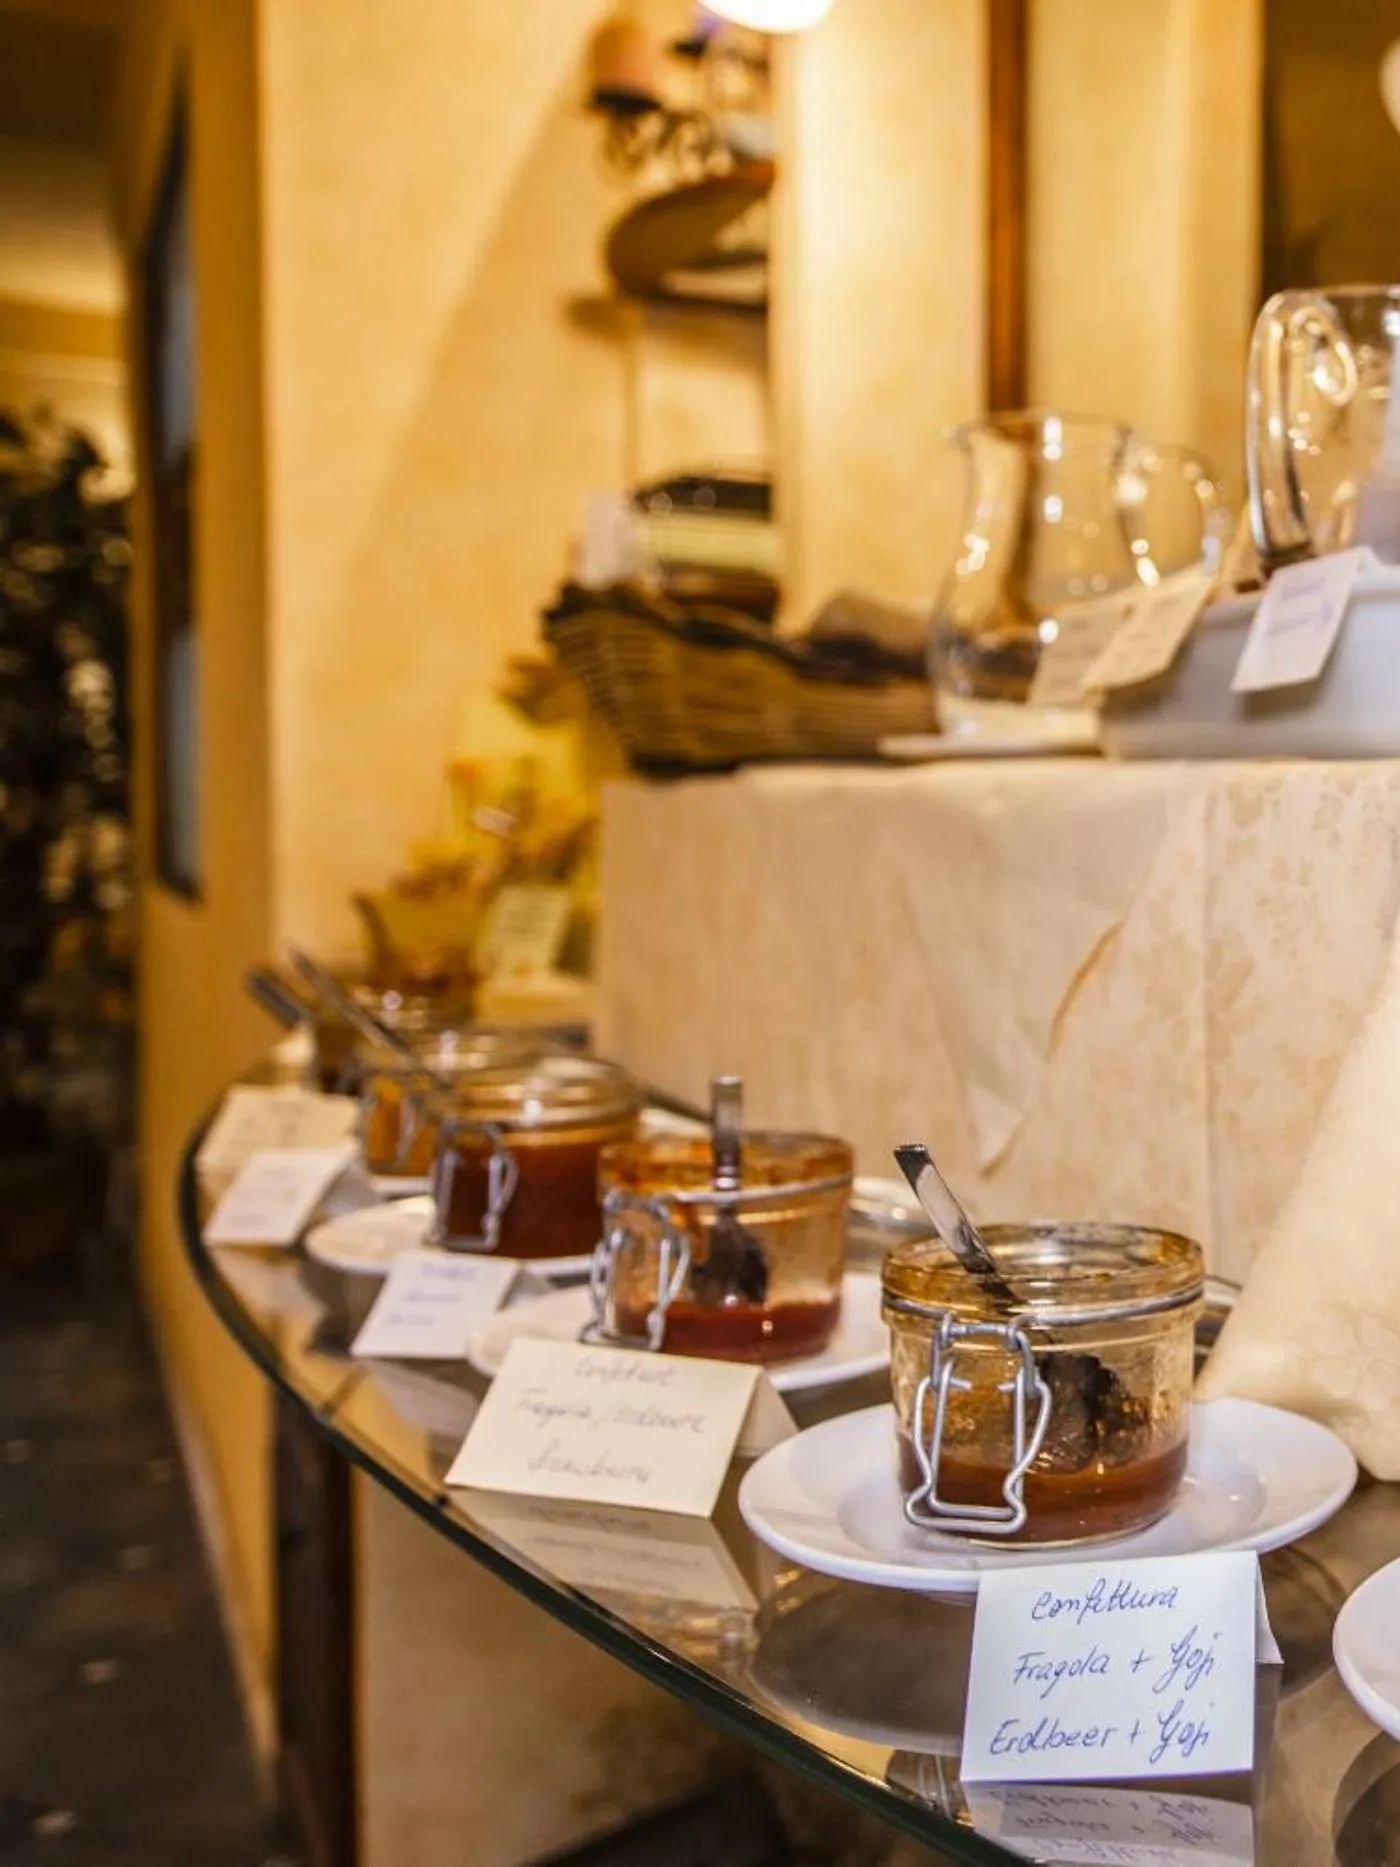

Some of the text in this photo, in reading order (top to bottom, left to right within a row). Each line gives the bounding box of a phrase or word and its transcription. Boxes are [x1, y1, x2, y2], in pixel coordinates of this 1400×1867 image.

[1032, 1578, 1180, 1625] Confettura
[1013, 1645, 1111, 1699] Fragola
[1130, 1649, 1152, 1674] +
[988, 1717, 1118, 1757] Erdbeer
[1129, 1718, 1147, 1745] +
